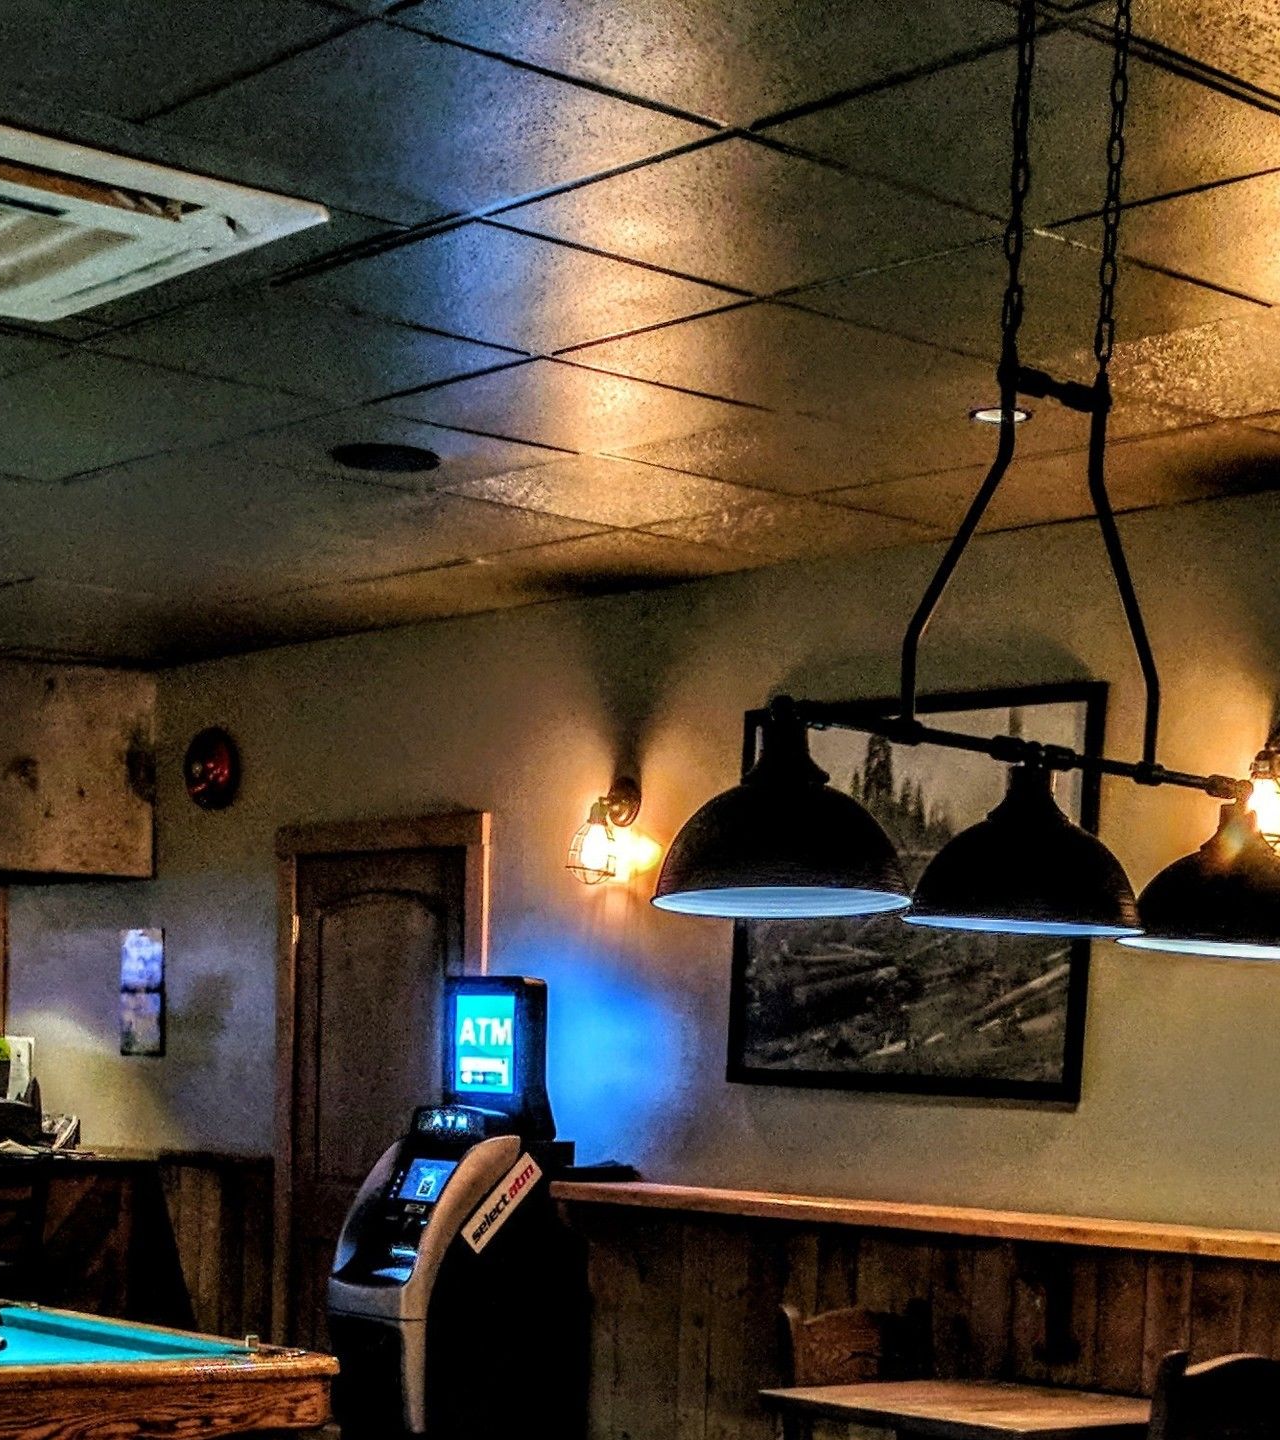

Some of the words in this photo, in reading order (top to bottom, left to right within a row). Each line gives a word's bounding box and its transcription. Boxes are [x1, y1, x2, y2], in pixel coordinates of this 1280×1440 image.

[459, 1016, 513, 1047] ATM
[432, 1115, 469, 1130] ATM
[471, 1192, 511, 1246] select
[507, 1163, 536, 1200] atm
